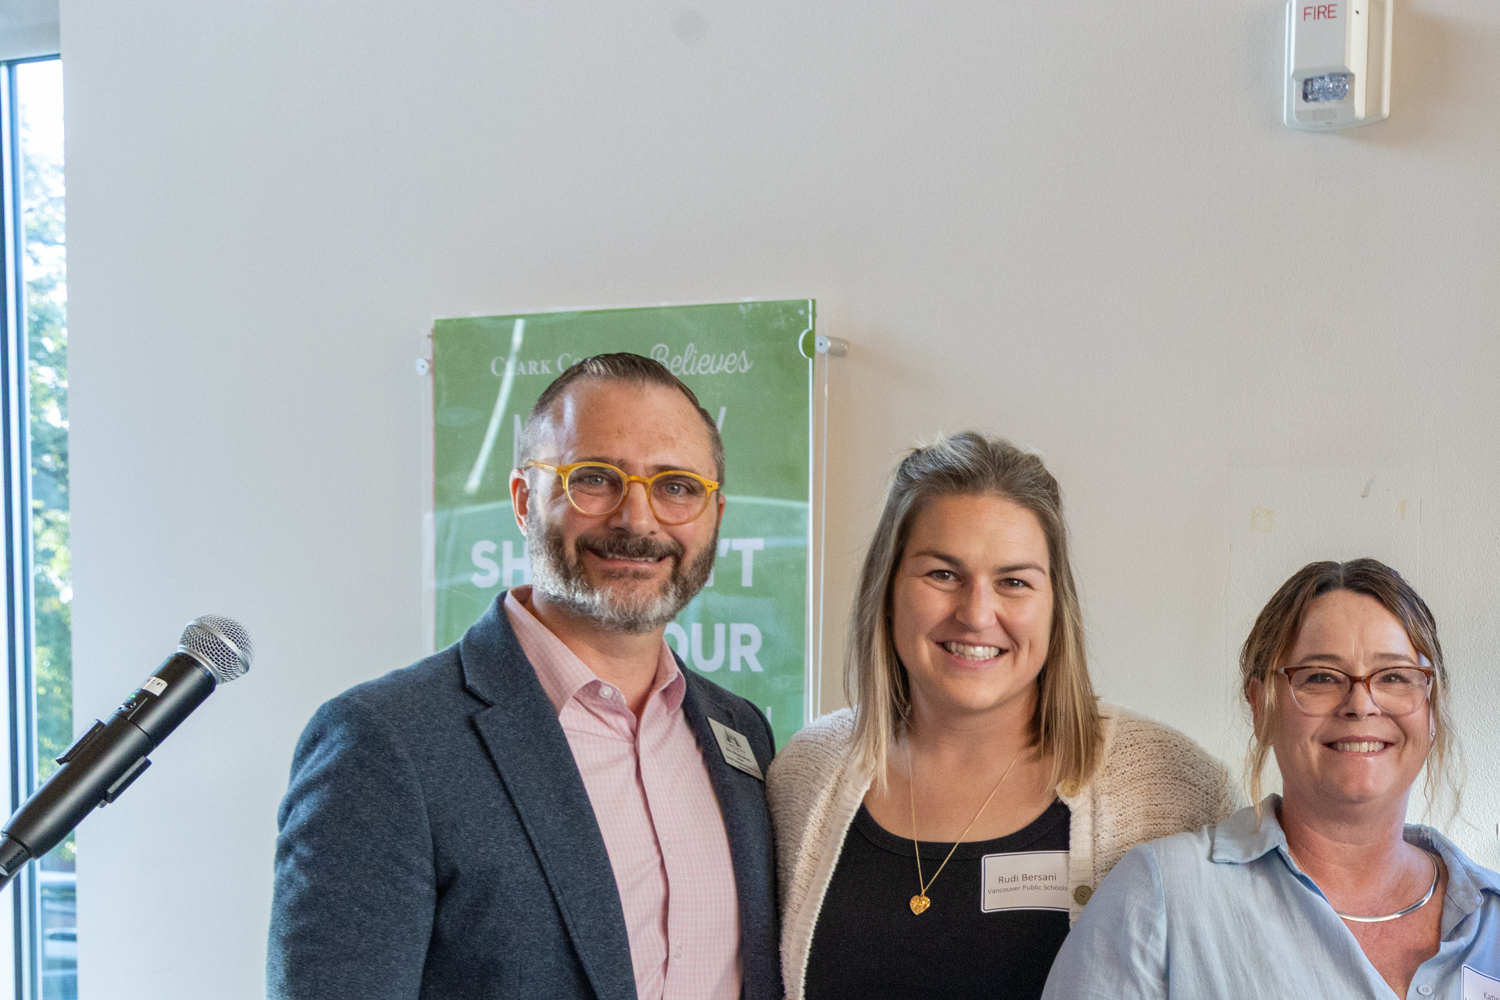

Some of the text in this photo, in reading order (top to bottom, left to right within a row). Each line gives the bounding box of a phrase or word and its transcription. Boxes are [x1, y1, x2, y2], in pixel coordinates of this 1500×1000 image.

[1303, 4, 1338, 21] FIRE
[650, 342, 754, 376] Believes
[998, 873, 1057, 884] Rudi Bersani
[987, 886, 1021, 895] Vancouver
[1043, 884, 1068, 892] Schools
